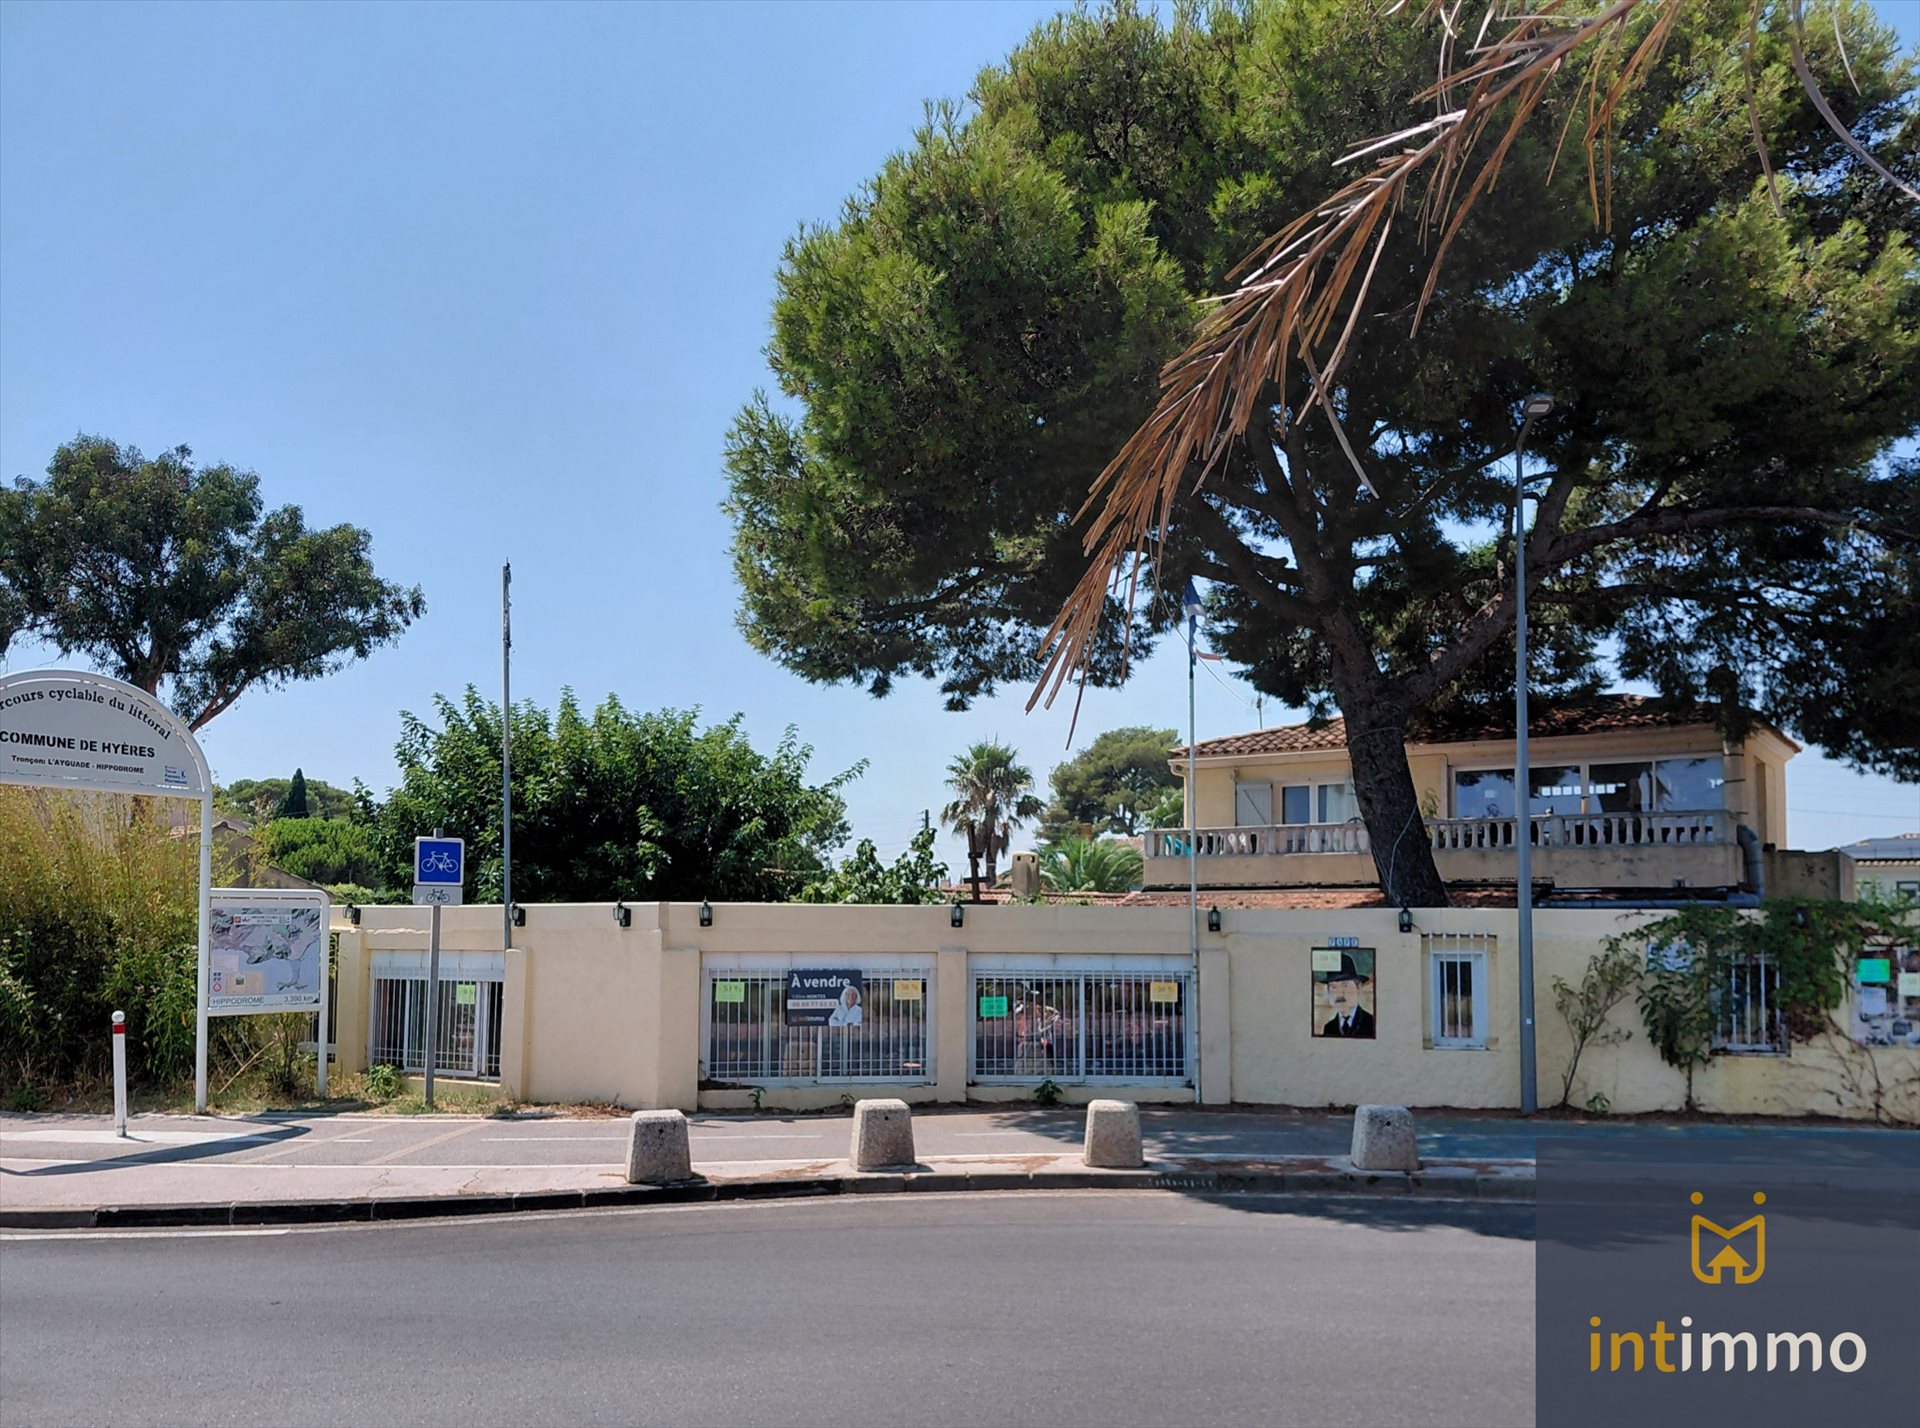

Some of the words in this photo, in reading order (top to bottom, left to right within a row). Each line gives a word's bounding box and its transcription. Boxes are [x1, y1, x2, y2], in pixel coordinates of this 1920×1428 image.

[49, 688, 104, 704] cyclable
[109, 697, 125, 711] du
[128, 704, 171, 740] littoral
[0, 731, 76, 749] COMMUNE
[80, 739, 97, 752] DE
[102, 741, 155, 758] HYÈRES
[96, 763, 144, 774] HIPPODROME
[791, 973, 801, 988] À
[803, 975, 851, 988] vendre
[213, 996, 264, 1005] HIPPODROME
